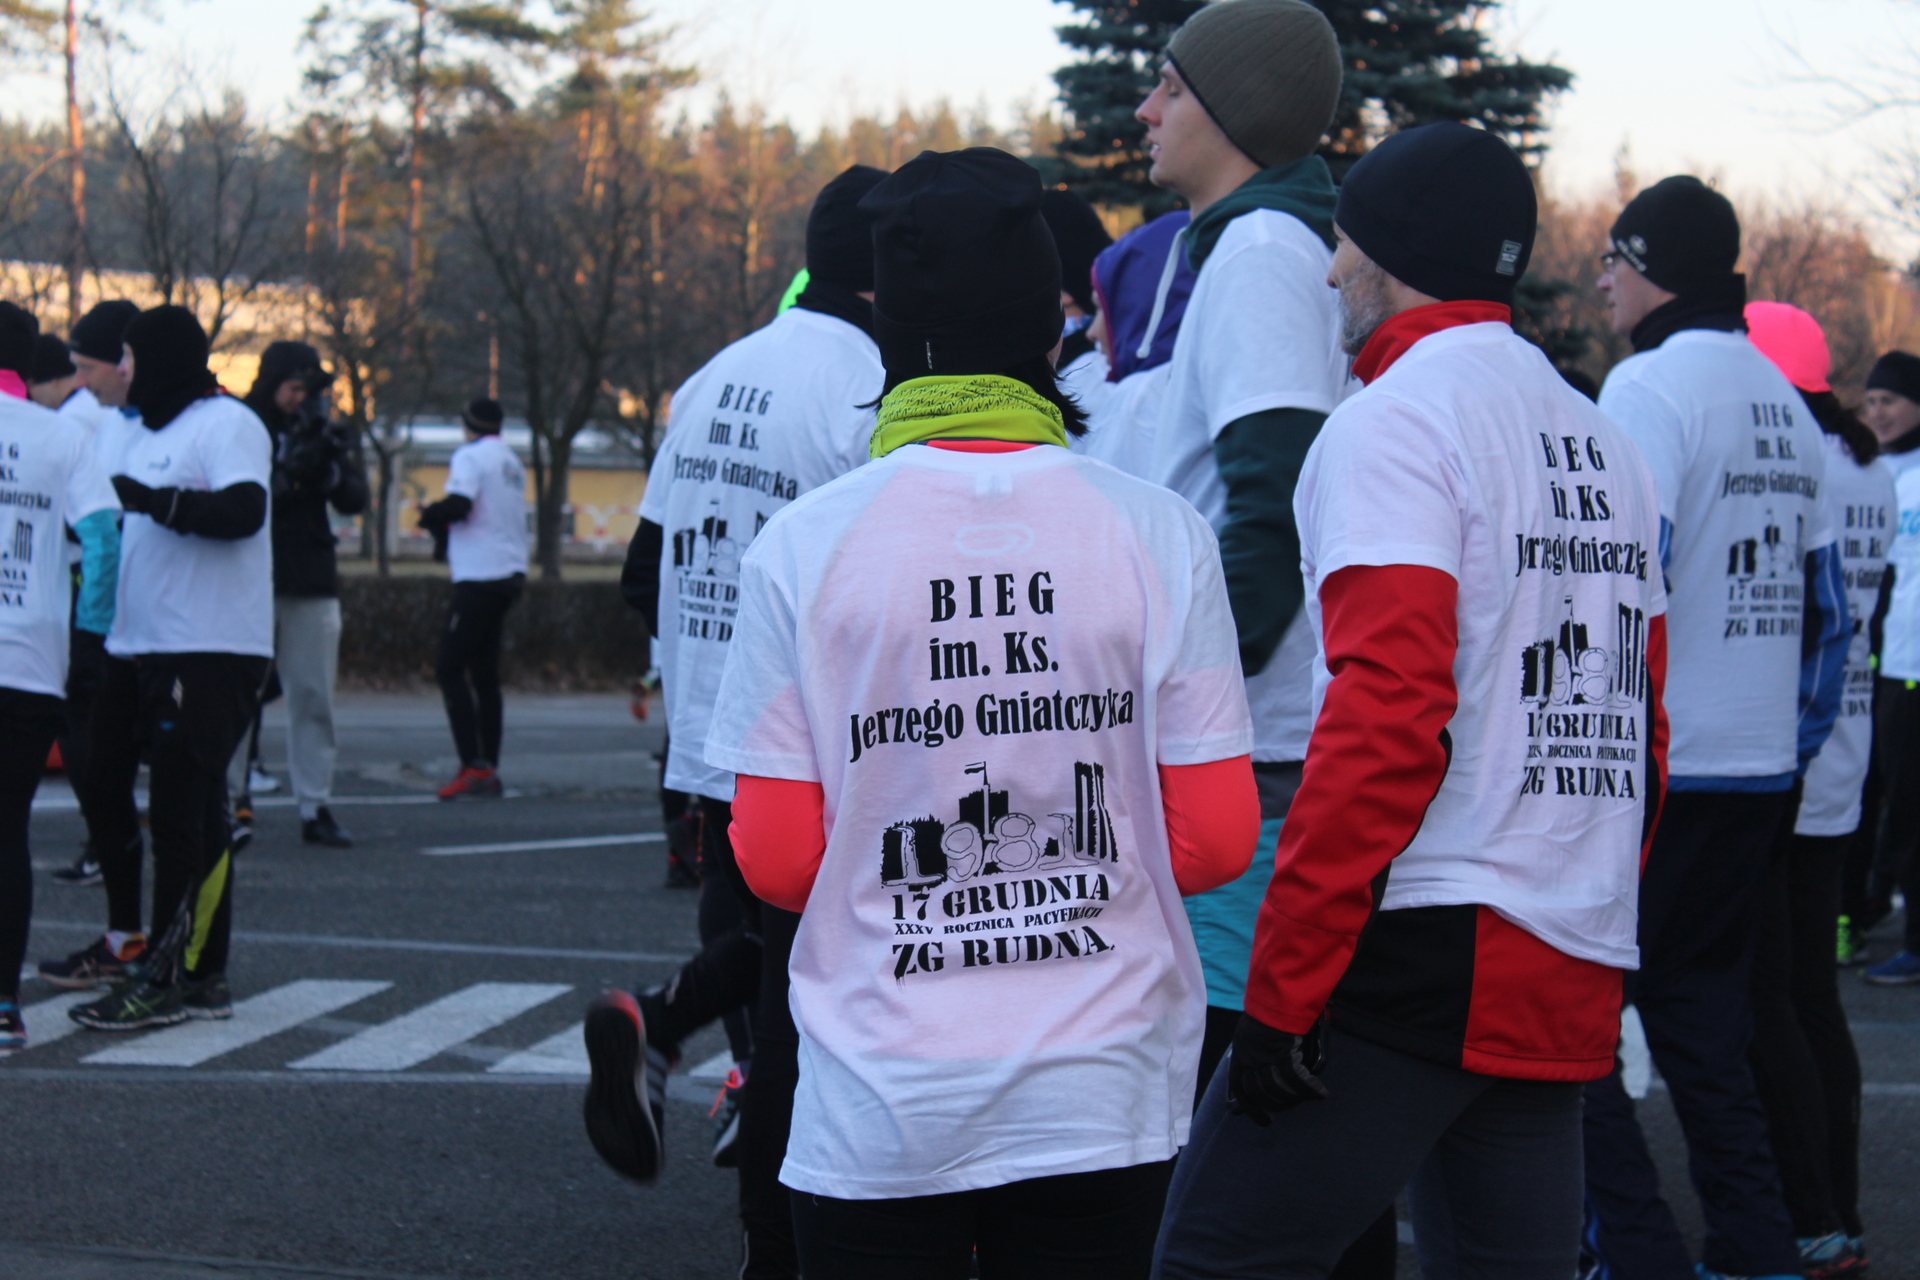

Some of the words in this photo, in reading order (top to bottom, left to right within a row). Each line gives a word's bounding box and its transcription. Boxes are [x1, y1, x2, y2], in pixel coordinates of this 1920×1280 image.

[718, 383, 773, 416] BIEG
[1751, 402, 1793, 427] BIEG
[1539, 432, 1606, 472] BEG
[1845, 505, 1886, 529] BIEG
[929, 571, 1054, 623] BIEG
[929, 638, 991, 681] im.
[1003, 631, 1059, 674] Ks.
[849, 699, 964, 763] Jerzego
[975, 688, 1134, 736] Gniatczyka
[1520, 766, 1545, 798] ZG
[881, 812, 1100, 886] 1981
[892, 893, 930, 920] 17
[942, 874, 1110, 917] GRUDNIA
[943, 917, 1014, 934] ROCZNICA
[1024, 906, 1104, 928] PACYFIKACJI
[892, 941, 945, 981] ZG
